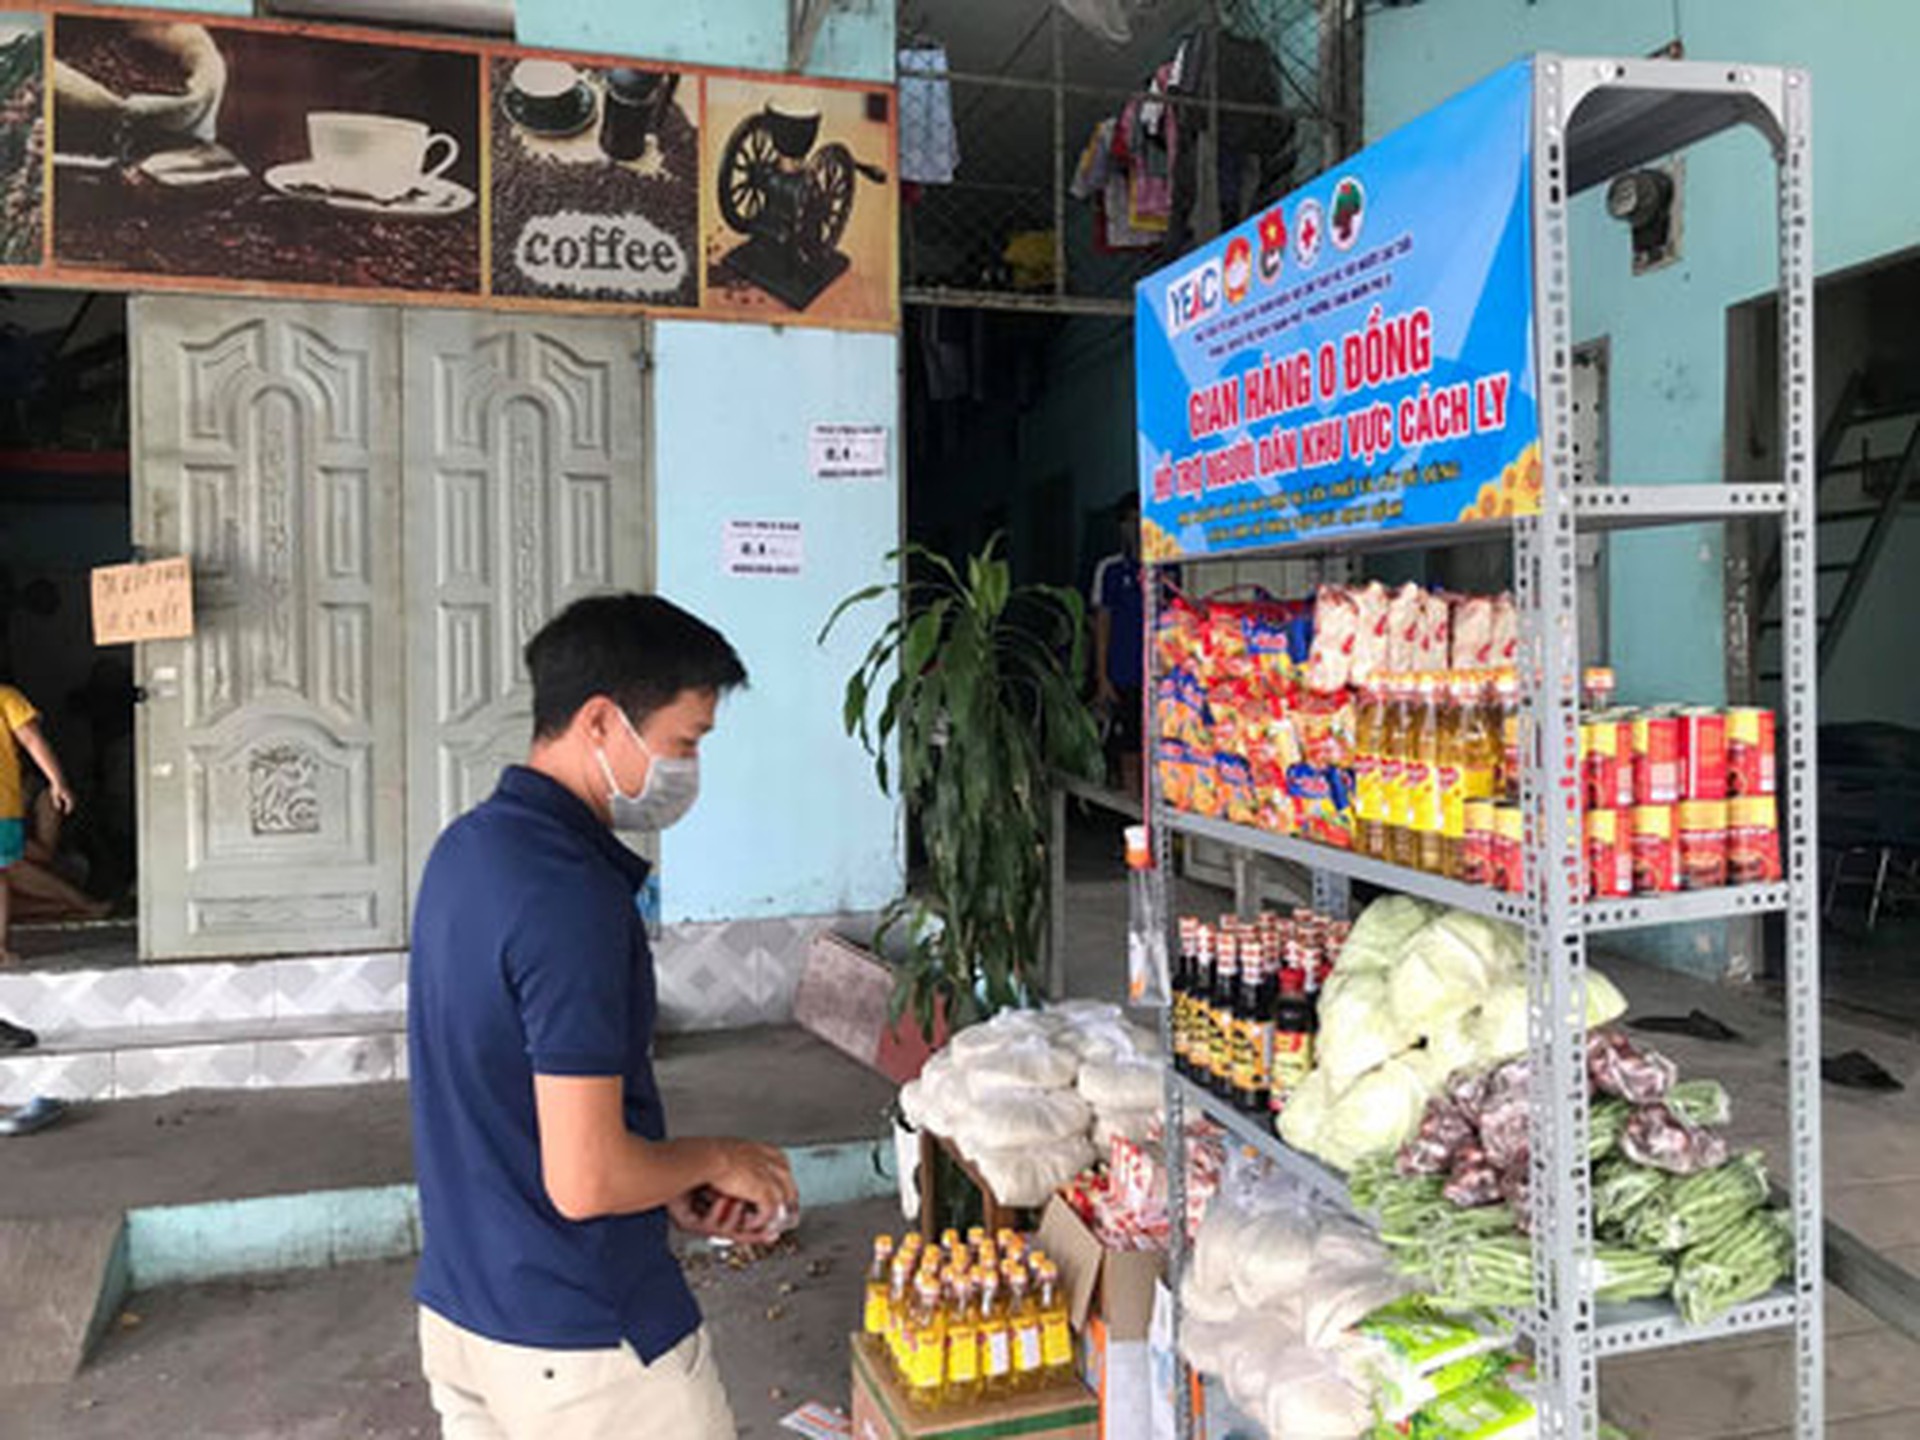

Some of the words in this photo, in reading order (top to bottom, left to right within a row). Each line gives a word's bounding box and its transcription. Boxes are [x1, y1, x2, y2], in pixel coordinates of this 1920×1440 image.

[524, 224, 678, 275] coffee
[1189, 379, 1239, 438] GIAN
[1344, 304, 1431, 391] ĐỒNG
[1302, 418, 1343, 467] KHU
[1347, 402, 1393, 464] VỰC
[1400, 384, 1470, 444] CÁCH
[1477, 375, 1508, 429] LY
